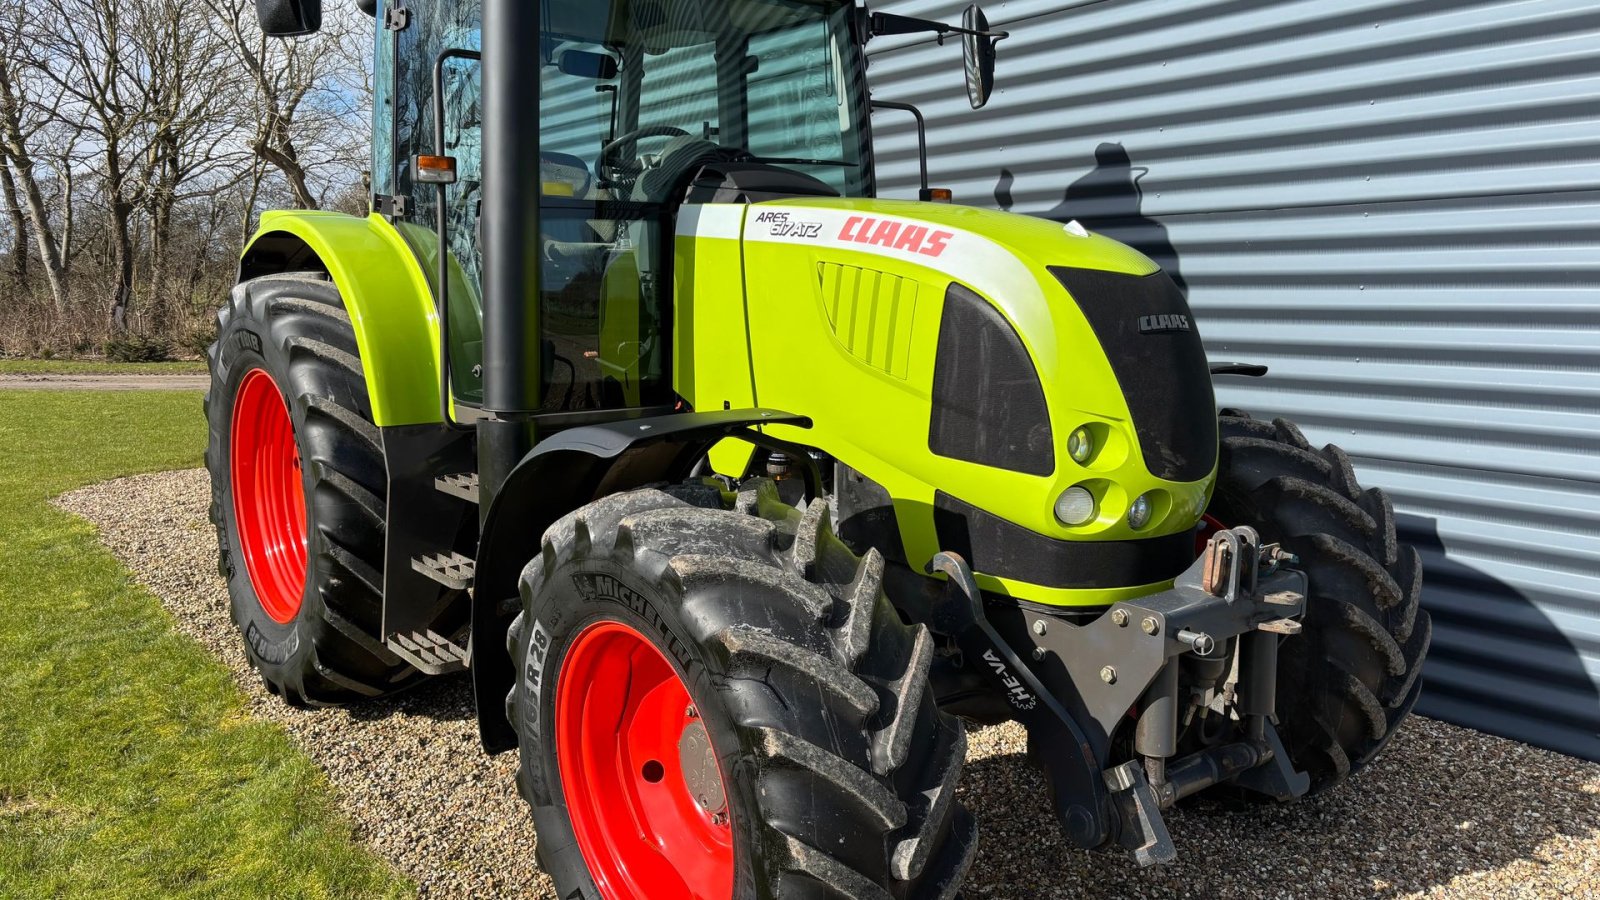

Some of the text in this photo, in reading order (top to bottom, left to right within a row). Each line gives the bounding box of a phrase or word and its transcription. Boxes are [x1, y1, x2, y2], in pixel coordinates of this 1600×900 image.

[755, 211, 790, 223] ARES
[837, 215, 954, 258] CLAAS
[1138, 314, 1190, 332] CLAAS
[595, 576, 691, 673] MICHELIN
[530, 629, 548, 664] 28
[982, 648, 1031, 701] HE-VA
